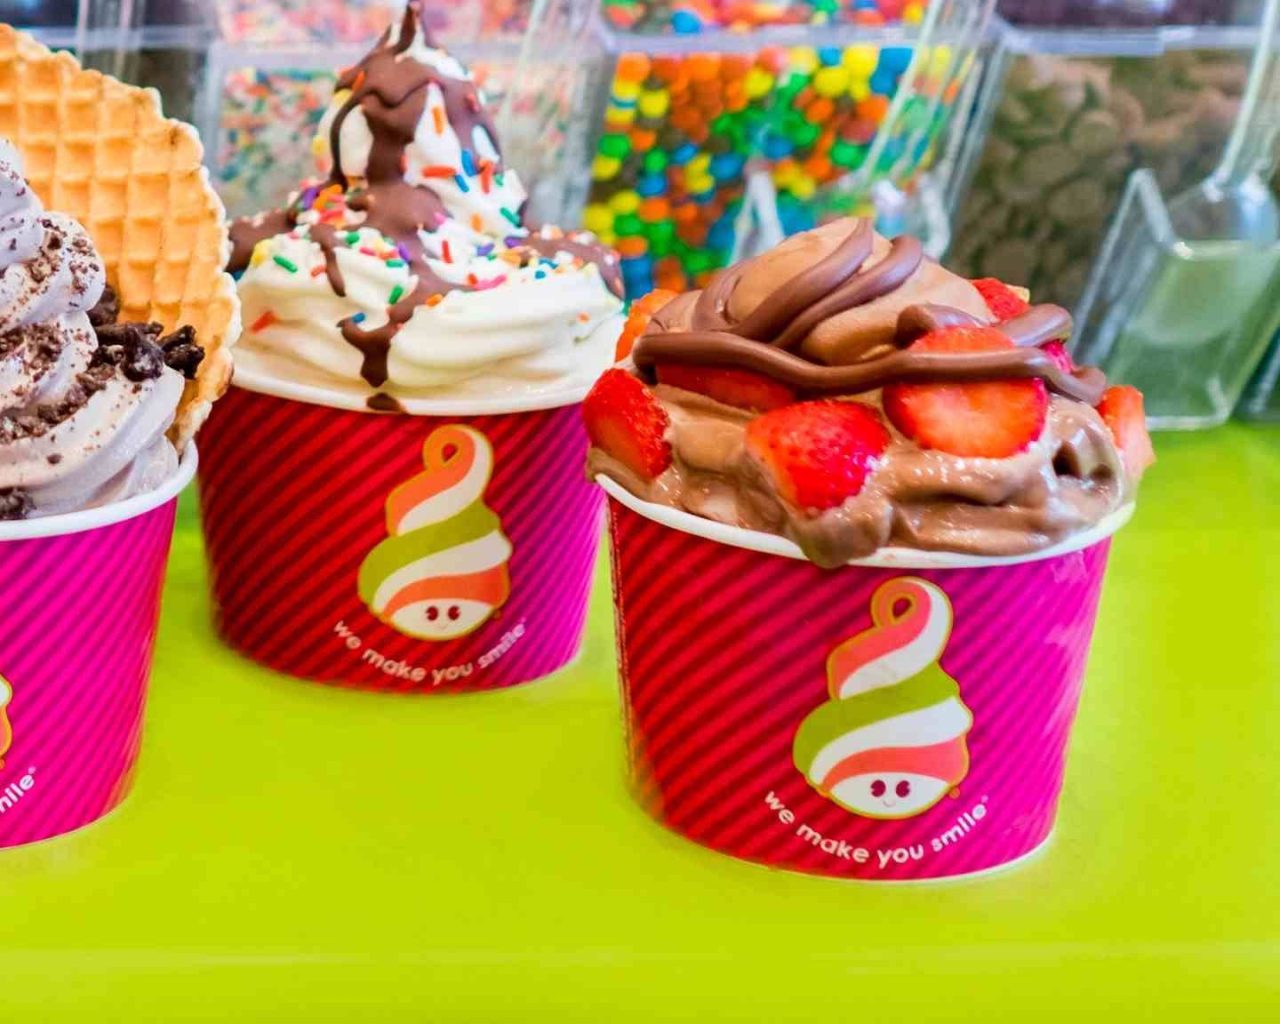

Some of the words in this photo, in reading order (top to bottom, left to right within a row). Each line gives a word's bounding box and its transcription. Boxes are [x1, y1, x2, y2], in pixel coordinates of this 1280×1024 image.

[333, 620, 362, 650] we
[362, 648, 427, 682] make
[431, 662, 474, 686] you
[764, 790, 795, 825] we
[795, 823, 870, 864] make
[876, 843, 924, 870] you
